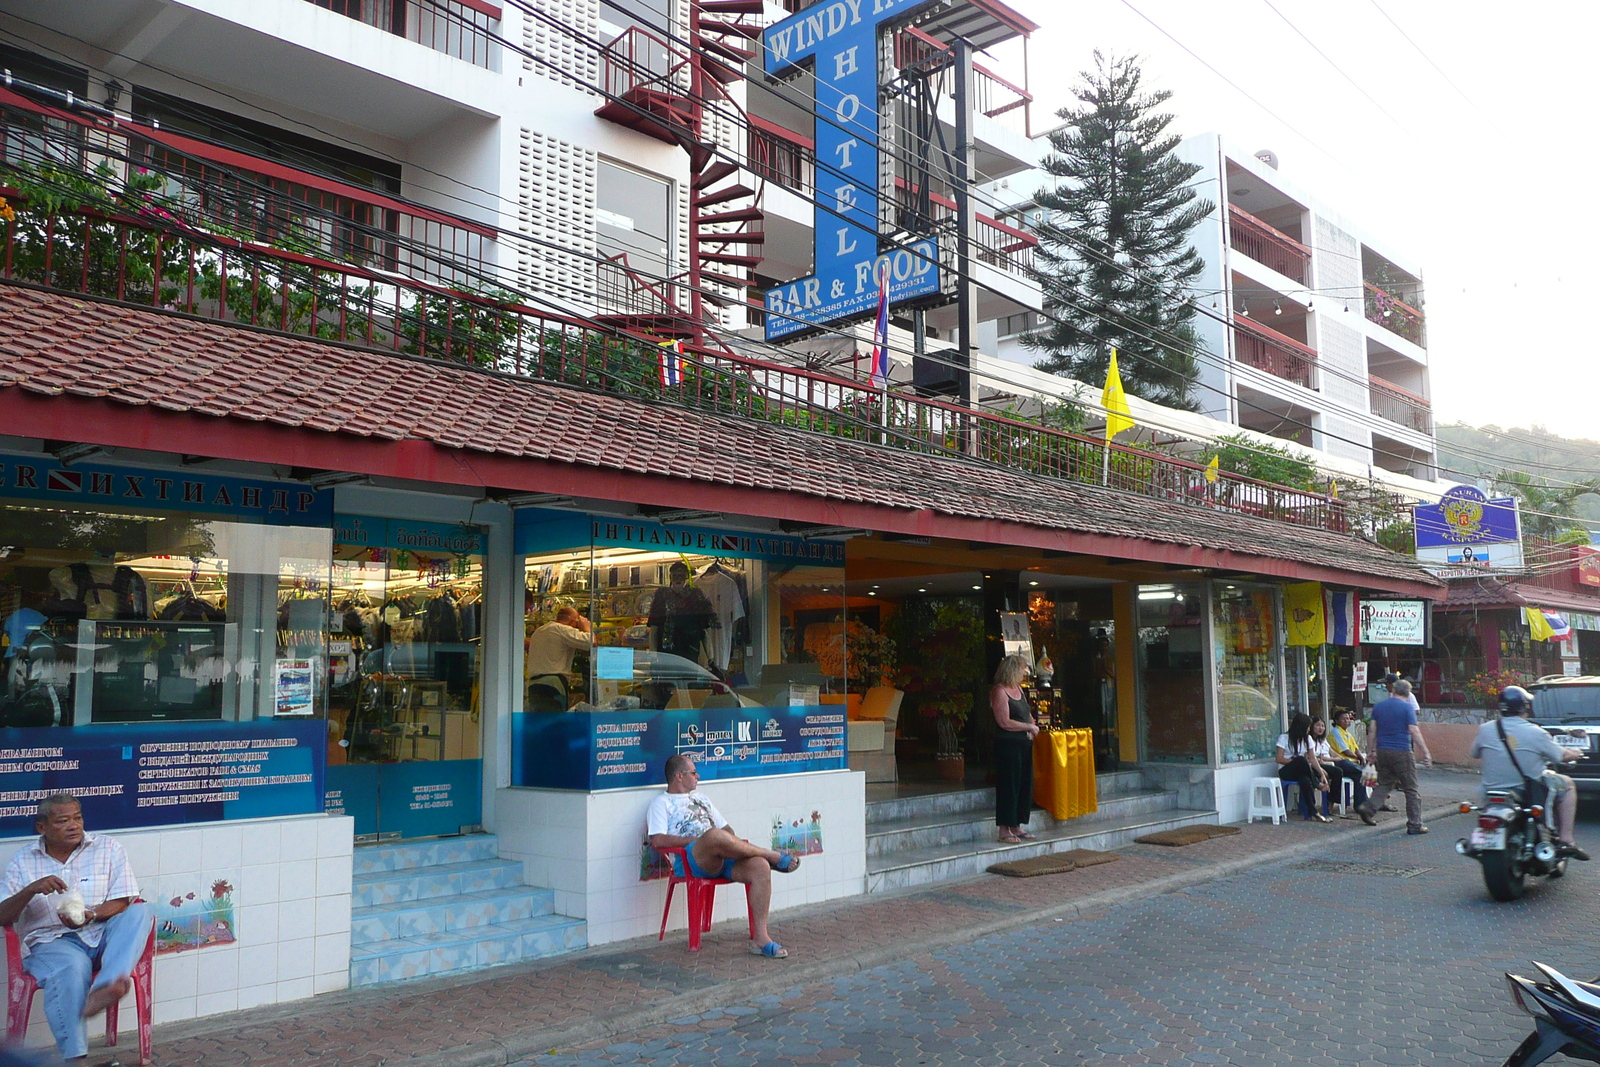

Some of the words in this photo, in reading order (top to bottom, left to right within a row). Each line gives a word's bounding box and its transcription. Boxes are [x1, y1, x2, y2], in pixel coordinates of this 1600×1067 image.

[769, 0, 862, 63] WINDY
[833, 45, 860, 257] HOTEL
[768, 278, 822, 321] BAR
[830, 278, 846, 299] &
[854, 243, 933, 295] FOOD
[88, 471, 315, 514] ИХТИАНДР
[593, 521, 721, 550] IHTIANDER
[741, 537, 845, 562] ИХТИАНДР
[596, 736, 641, 748] EQUIPMENT
[738, 721, 752, 742] UK
[140, 741, 189, 753] ОБУЧЕНИЕ
[189, 740, 250, 752] ПОДВОДНОМУ
[24, 760, 80, 772] ОСТРОВАМ
[139, 756, 147, 767] С
[147, 753, 191, 766] ВЫДАЧЕЙ
[191, 751, 269, 764] МЕЖДУНАРОДНЫХ
[596, 762, 647, 775] ACCESSORIES
[138, 768, 209, 780] СЕРТИФИКАТОВ
[230, 765, 237, 775] &
